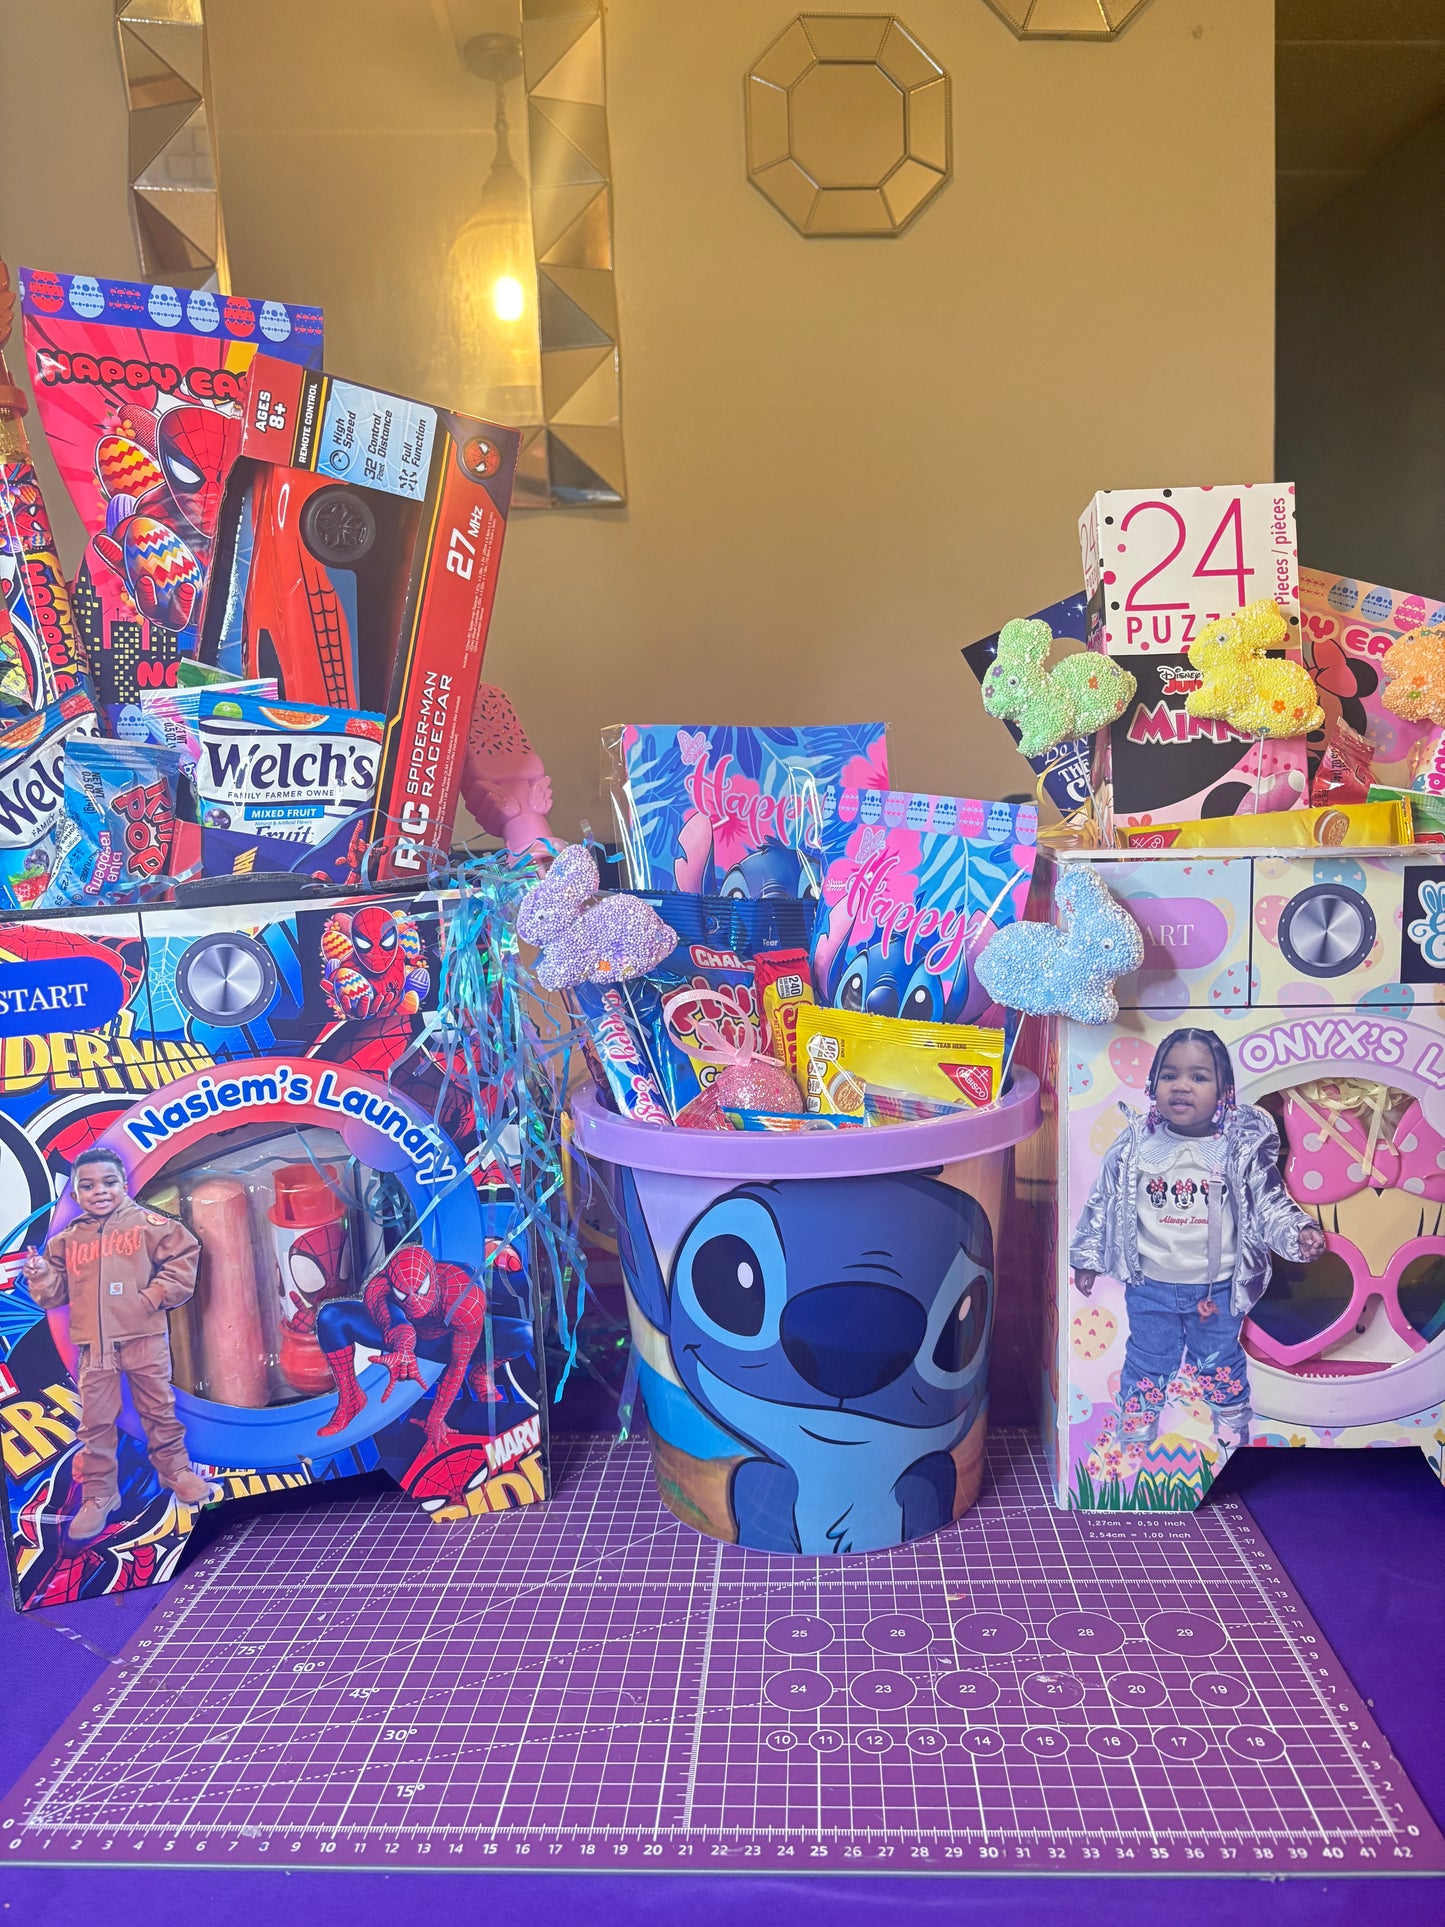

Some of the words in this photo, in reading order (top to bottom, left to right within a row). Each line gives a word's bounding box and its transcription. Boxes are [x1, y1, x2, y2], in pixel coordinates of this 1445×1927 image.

[37, 349, 181, 393] HAPPY
[256, 391, 271, 432] AGES
[269, 402, 287, 430] 8+
[304, 383, 317, 425] CONTROL
[298, 426, 311, 464] REMOTE
[333, 417, 345, 445] High
[342, 411, 356, 449] Speed
[368, 413, 381, 453] Control
[379, 410, 393, 458] Distance
[411, 419, 426, 467] Function
[402, 443, 412, 463] Full
[364, 458, 377, 480] 32
[1271, 497, 1292, 545] pièces
[446, 529, 475, 581] 27
[467, 505, 484, 538] MHz
[1121, 498, 1255, 611] 24
[1274, 558, 1290, 605] Pieces
[1127, 612, 1236, 645] PUZ
[406, 671, 437, 795] SPIDER-MAN
[421, 674, 453, 797] RACECAR
[81, 770, 92, 782] 0.5
[91, 770, 102, 786] NET
[202, 742, 374, 790] Welch's
[94, 786, 104, 799] WT
[265, 791, 302, 800] FARMER
[306, 789, 343, 798] OWNE
[684, 753, 826, 848] Happy
[252, 808, 285, 818] MIXED
[286, 807, 317, 817] FRUIT
[111, 787, 165, 878] POP
[394, 800, 430, 871] RC
[85, 831, 113, 897] raspberry
[106, 851, 123, 884] blue
[847, 852, 976, 975] Happy
[762, 938, 778, 946] Tear
[1142, 924, 1194, 947] ART
[788, 976, 801, 995] 240
[1242, 1021, 1405, 1070] ONYX'S
[126, 1069, 309, 1150] Nasiem's
[138, 1640, 152, 1648] 10
[791, 1629, 808, 1638] 25
[890, 1629, 906, 1638] 26
[982, 1628, 998, 1637] 27
[1078, 1628, 1094, 1637] 28
[1176, 1628, 1193, 1637] 29
[1300, 1636, 1316, 1644] 10
[292, 1662, 325, 1673] 60°
[790, 1684, 807, 1693] 24
[875, 1684, 892, 1693] 23
[959, 1684, 977, 1693] 22
[1046, 1684, 1063, 1694] 21
[1128, 1685, 1146, 1694] 20
[1210, 1685, 1227, 1695] 19
[79, 1721, 90, 1730] 5
[383, 1729, 418, 1741] 30°
[1348, 1721, 1359, 1731] 5
[774, 1736, 791, 1745] 10
[818, 1736, 834, 1745] 11
[866, 1736, 884, 1745] 12
[918, 1736, 936, 1746] 13
[974, 1736, 991, 1746] 14
[1037, 1737, 1055, 1747] 15
[1103, 1737, 1121, 1747] 16
[1171, 1737, 1188, 1747] 17
[1246, 1737, 1265, 1747] 18
[2, 1818, 15, 1829] 0
[1407, 1825, 1420, 1837] 0
[8, 1838, 22, 1850] 0
[42, 1839, 52, 1850] 1
[70, 1839, 82, 1850] 2
[101, 1839, 114, 1851] 3
[132, 1840, 144, 1851] 4
[164, 1840, 176, 1851] 5
[196, 1840, 208, 1852] 6
[228, 1841, 239, 1852] 7
[258, 1841, 270, 1852] 8
[290, 1841, 302, 1852] 9
[319, 1842, 337, 1853] 10
[354, 1842, 367, 1853] 11
[384, 1842, 400, 1854] 12
[416, 1843, 432, 1854] 13
[448, 1843, 464, 1854] 14
[482, 1844, 498, 1855] 15
[514, 1844, 531, 1855] 16
[548, 1844, 564, 1855] 17
[580, 1844, 596, 1855] 18
[612, 1844, 630, 1855] 19
[643, 1844, 664, 1856] 20
[678, 1844, 694, 1856] 21
[710, 1845, 728, 1856] 22
[744, 1845, 762, 1856] 23
[776, 1845, 795, 1857] 24
[810, 1846, 828, 1857] 25
[844, 1846, 862, 1857] 26
[878, 1846, 895, 1857] 27
[910, 1846, 929, 1858] 28
[944, 1847, 963, 1858] 29
[979, 1847, 998, 1858] 30
[1015, 1847, 1031, 1858] 31
[1048, 1847, 1066, 1859] 32
[1083, 1848, 1100, 1859] 33
[1116, 1848, 1134, 1859] 34
[1150, 1848, 1169, 1859] 35
[1185, 1848, 1204, 1859] 36
[1221, 1848, 1237, 1859] 37
[1254, 1848, 1274, 1859] 38
[1290, 1848, 1308, 1859] 39
[1322, 1848, 1344, 1859] 40
[1360, 1848, 1376, 1859] 41
[1392, 1848, 1413, 1859] 42
